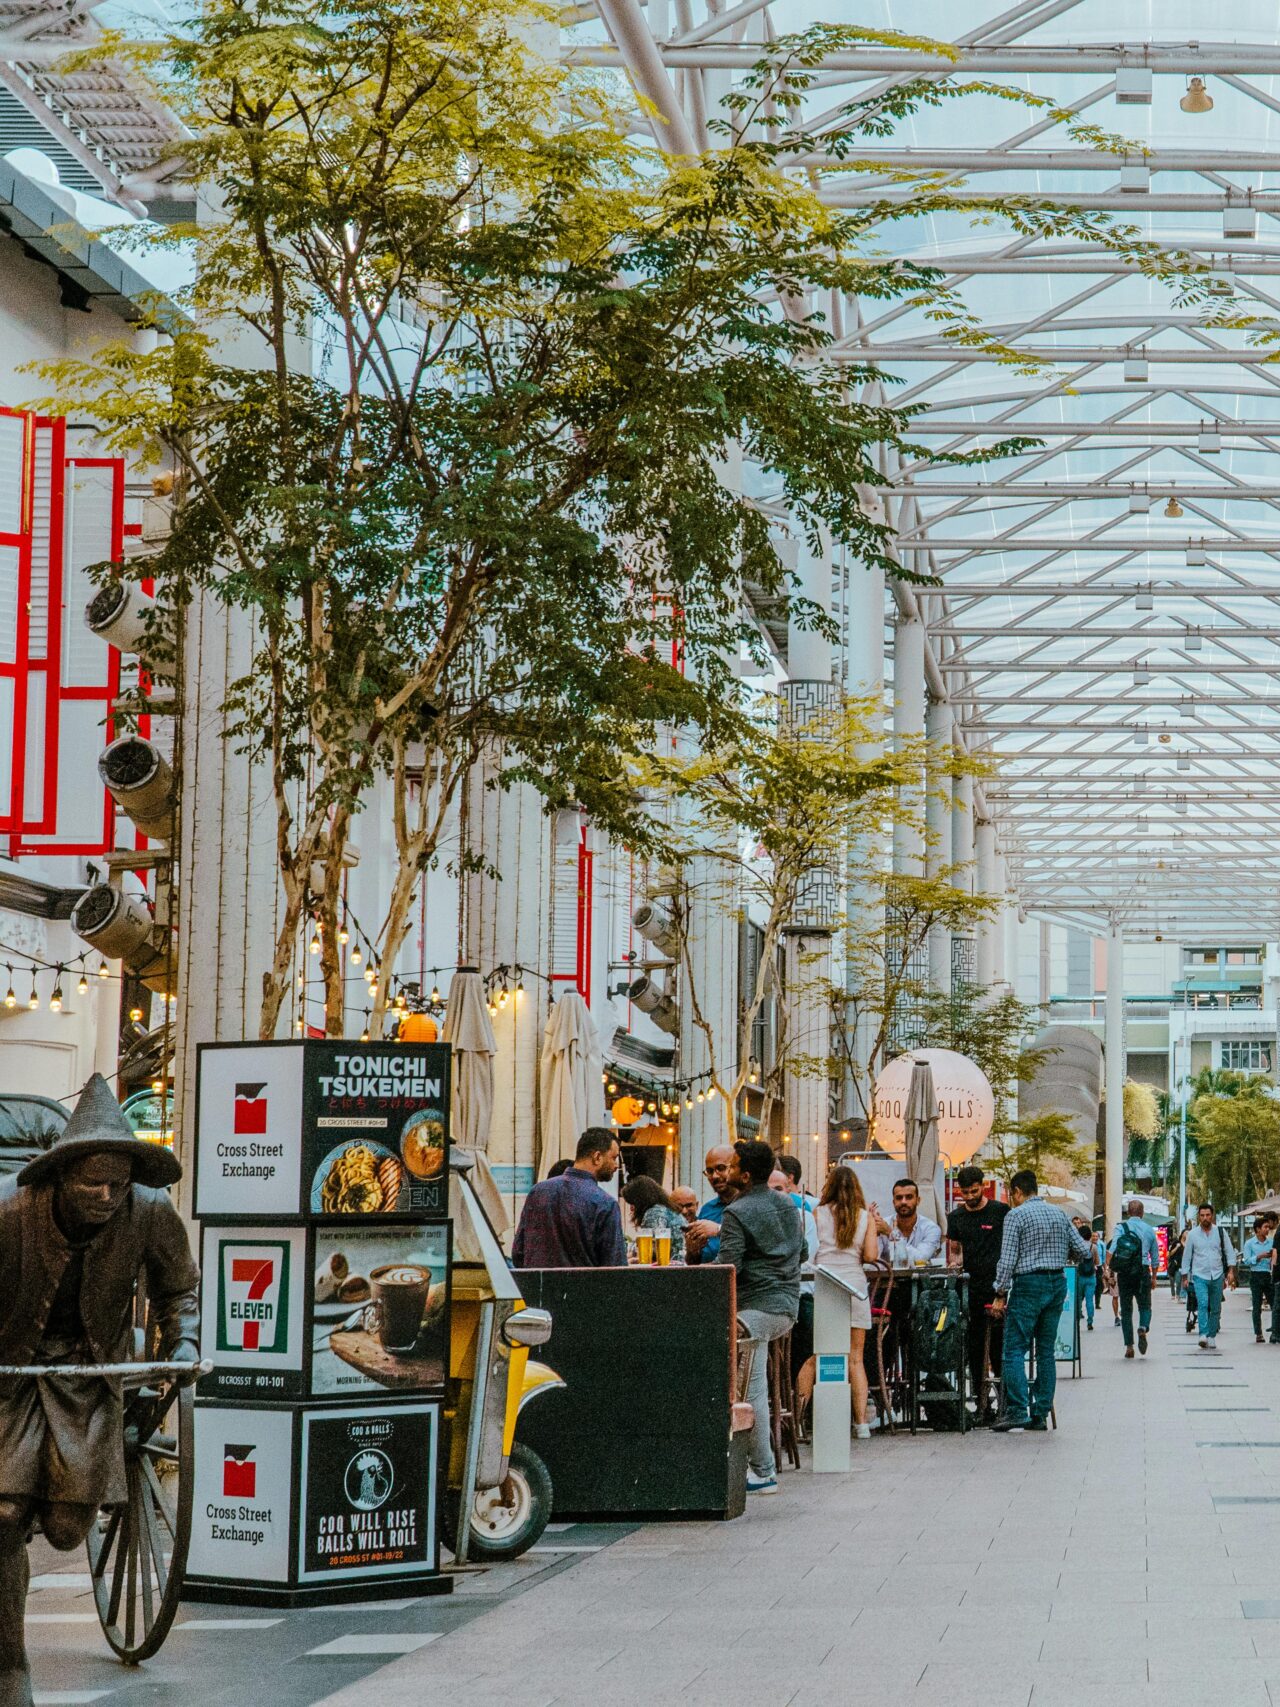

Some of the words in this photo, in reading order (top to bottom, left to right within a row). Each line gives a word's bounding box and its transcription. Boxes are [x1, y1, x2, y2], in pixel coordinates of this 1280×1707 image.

[335, 1056, 426, 1077] TONICHI
[319, 1077, 441, 1098] TSUKEMEN
[879, 1100, 900, 1118] COQ
[938, 1100, 973, 1118] ALLS
[217, 1143, 247, 1157] Cross
[250, 1143, 283, 1157] Street
[222, 1163, 275, 1180] Exchange
[225, 1376, 244, 1385] CROSS
[244, 1377, 252, 1385] ST
[256, 1376, 284, 1387] #01-101
[336, 1376, 362, 1385] MORNING
[352, 1426, 364, 1436] COQ
[371, 1424, 390, 1435] BALLS
[206, 1504, 237, 1522] Cross
[238, 1505, 272, 1523] Street
[319, 1515, 344, 1535] COQ
[350, 1512, 380, 1531] WILL
[387, 1509, 416, 1528] RISE
[211, 1525, 264, 1546] Exchange
[317, 1533, 353, 1554] BALLS
[358, 1531, 385, 1550] WILL
[389, 1528, 417, 1547] ROLL
[329, 1557, 339, 1565] 20
[339, 1555, 361, 1564] CROSS
[361, 1554, 370, 1562] ST
